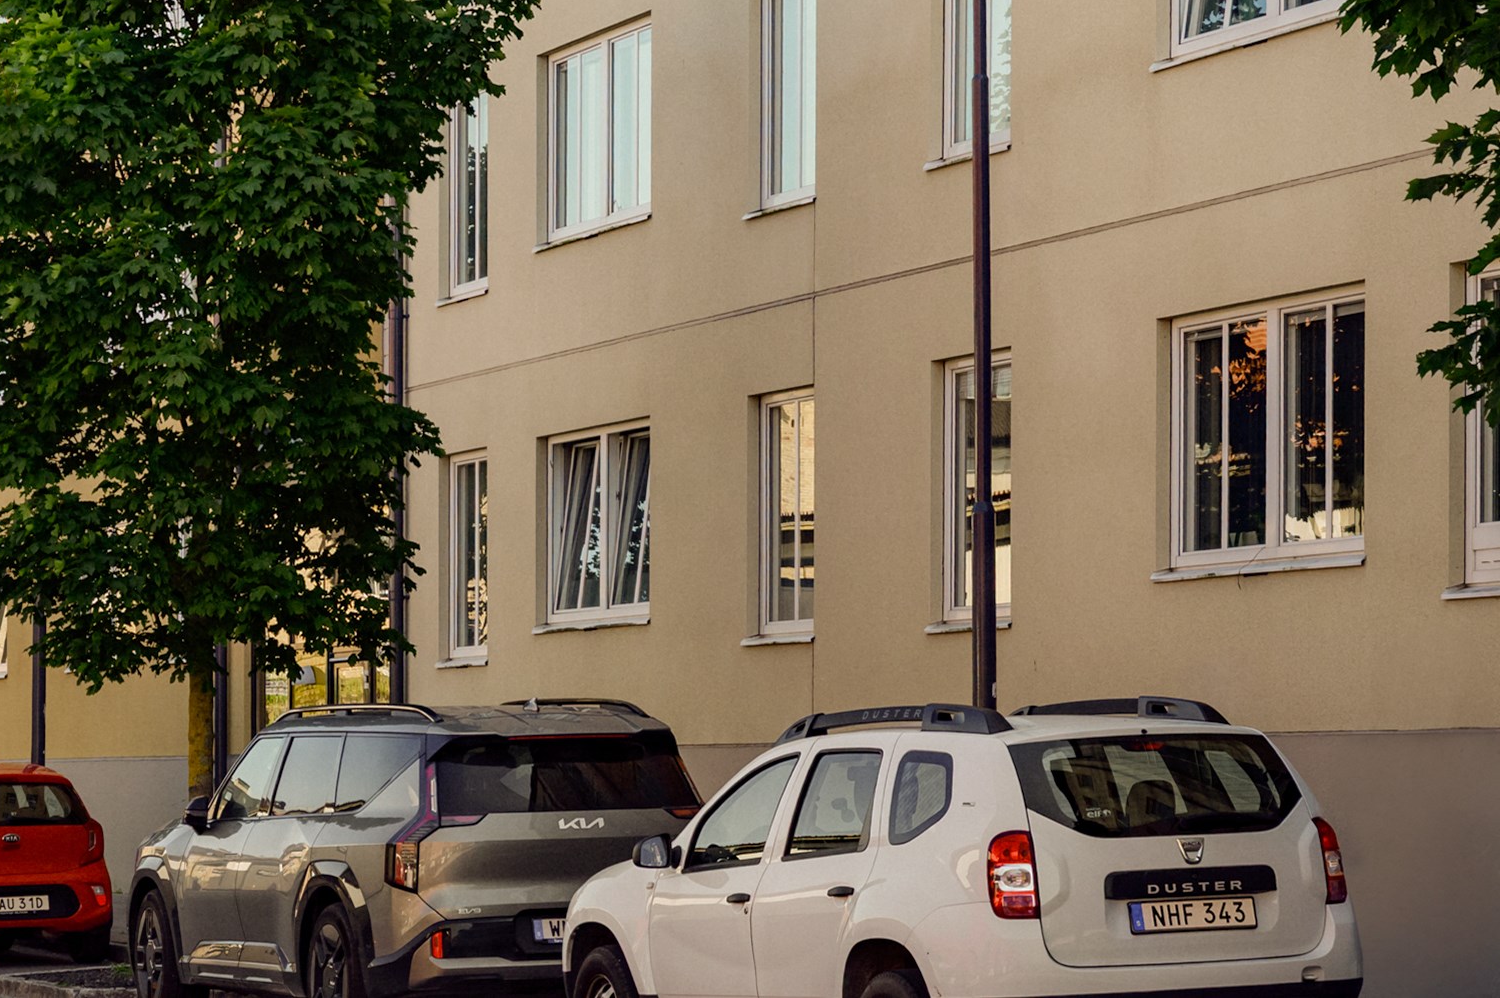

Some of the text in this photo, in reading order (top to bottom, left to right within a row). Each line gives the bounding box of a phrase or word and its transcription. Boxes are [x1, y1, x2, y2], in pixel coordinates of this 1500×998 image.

[862, 709, 921, 720] DUSTER
[1147, 880, 1242, 894] DUSTER
[18, 896, 43, 909] 31D
[1151, 901, 1246, 927] NHF 343
[549, 920, 566, 937] W
